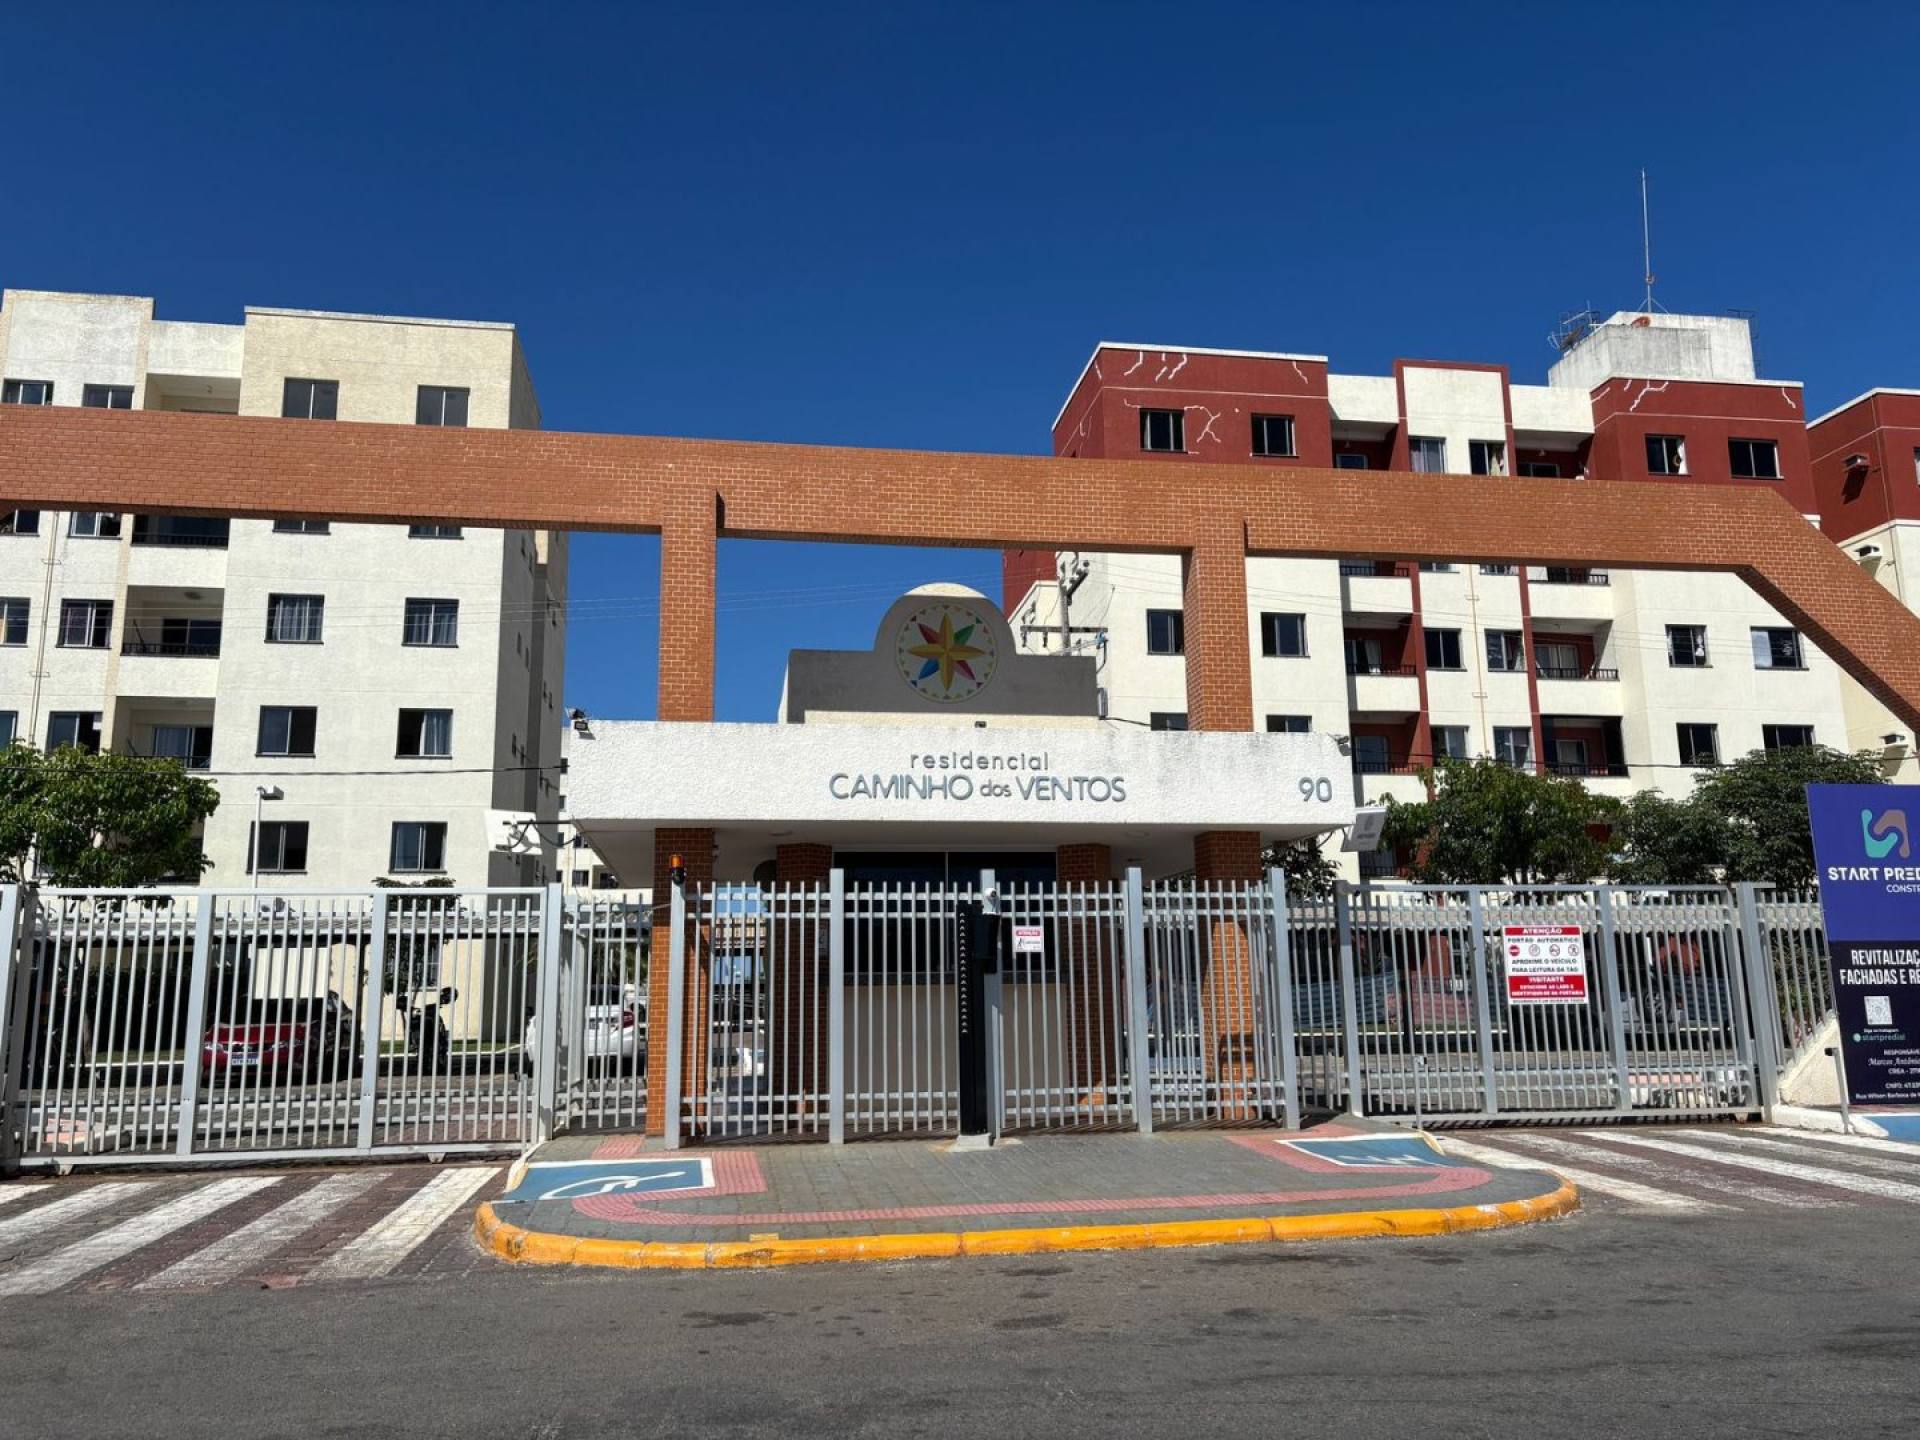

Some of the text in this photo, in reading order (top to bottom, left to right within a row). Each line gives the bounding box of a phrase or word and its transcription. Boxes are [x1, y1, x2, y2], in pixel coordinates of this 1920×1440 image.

[910, 750, 1049, 771] residencial
[828, 772, 1126, 802] CAMINHO dos VENTOS
[1299, 776, 1333, 803] 90
[1828, 866, 1879, 881] START
[1522, 927, 1562, 936] ATENÇÃO
[1840, 968, 1898, 985] FACHADAS
[1899, 968, 1907, 985] E
